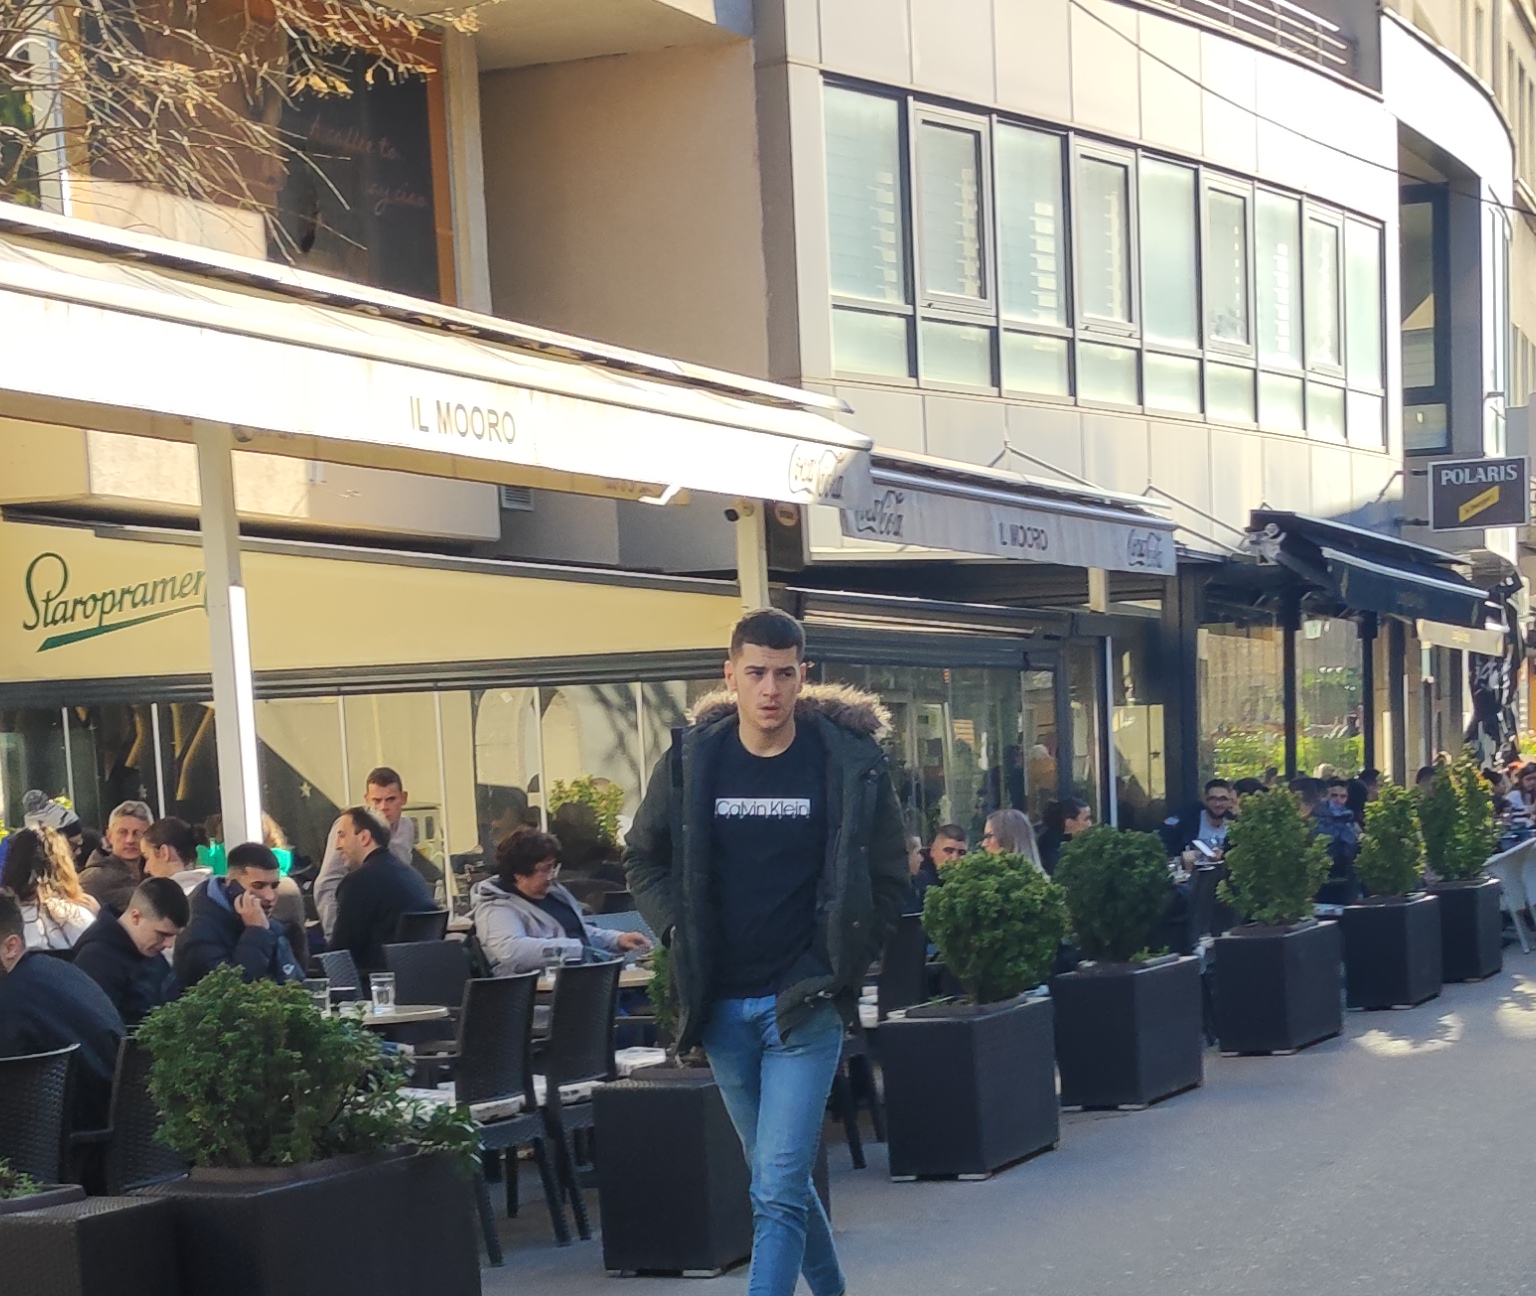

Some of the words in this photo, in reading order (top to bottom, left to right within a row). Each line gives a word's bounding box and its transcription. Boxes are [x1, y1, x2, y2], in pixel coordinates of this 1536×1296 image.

[409, 395, 429, 432] IL
[436, 399, 516, 444] MOORO
[1440, 464, 1518, 486] POLARIS
[716, 800, 767, 816] Calvin
[770, 800, 810, 816] Klein
